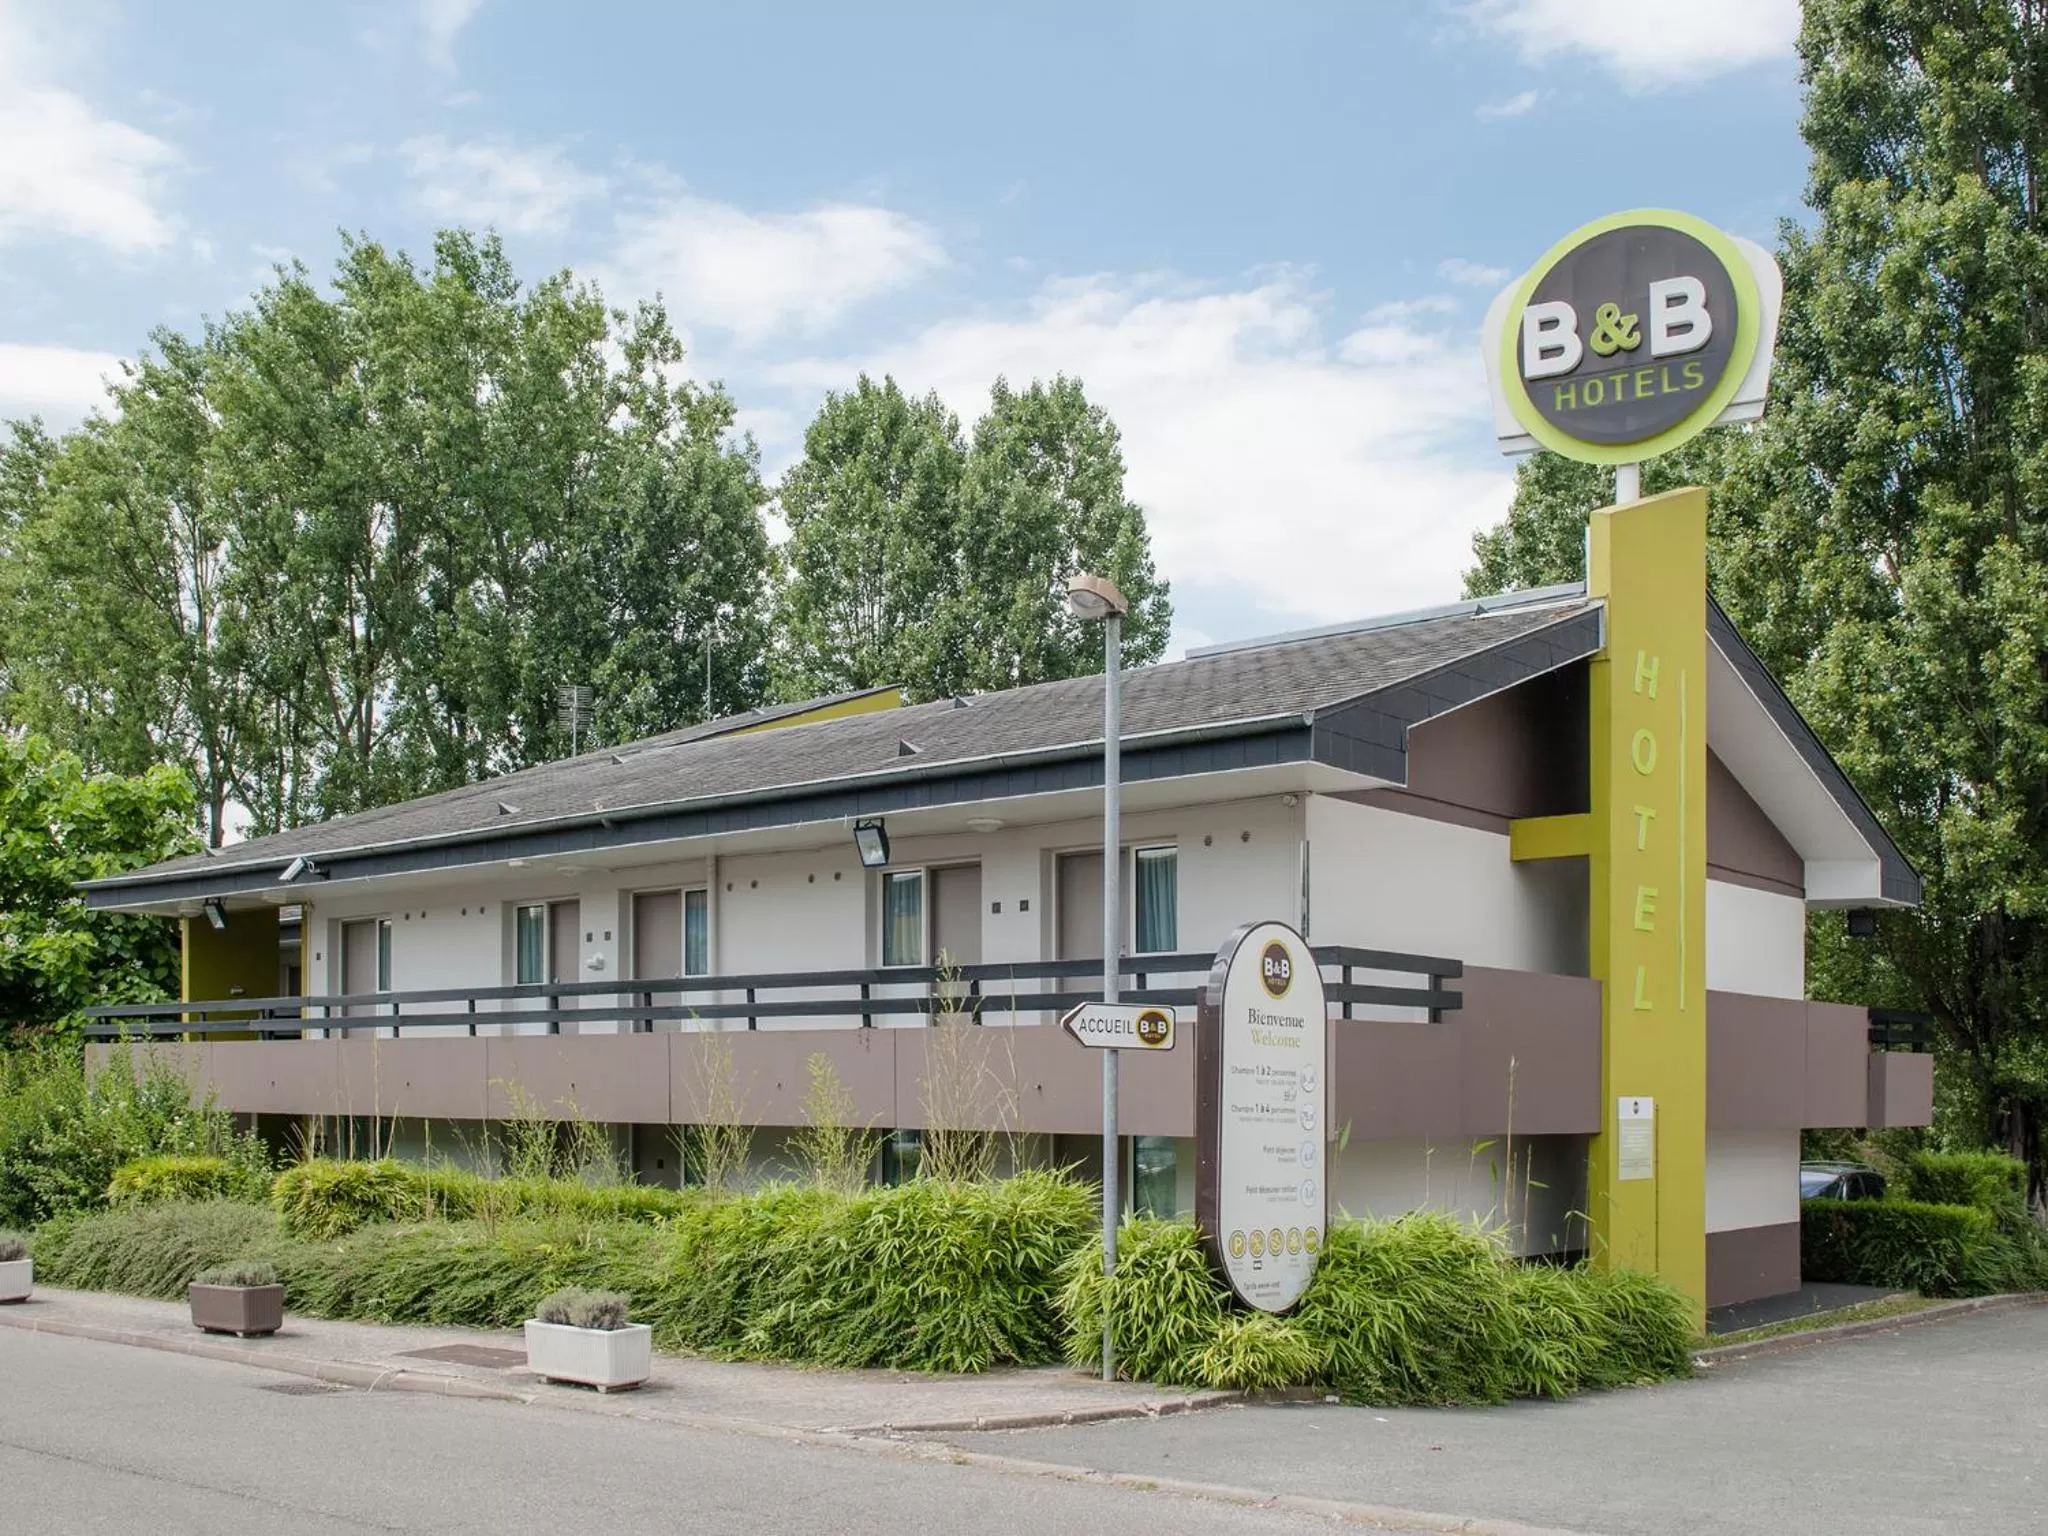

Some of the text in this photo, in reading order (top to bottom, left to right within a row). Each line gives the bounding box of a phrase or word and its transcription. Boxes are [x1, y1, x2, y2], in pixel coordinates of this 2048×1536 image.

[1523, 275, 1713, 382] B&B
[1554, 361, 1704, 412] HOTELS
[1632, 649, 1659, 1012] HOTEL
[1264, 957, 1290, 978] B&B
[1079, 1018, 1167, 1035] ACCUEIL B&B
[1248, 1008, 1304, 1028] Bienvenue
[1251, 1028, 1301, 1048] Welcome
